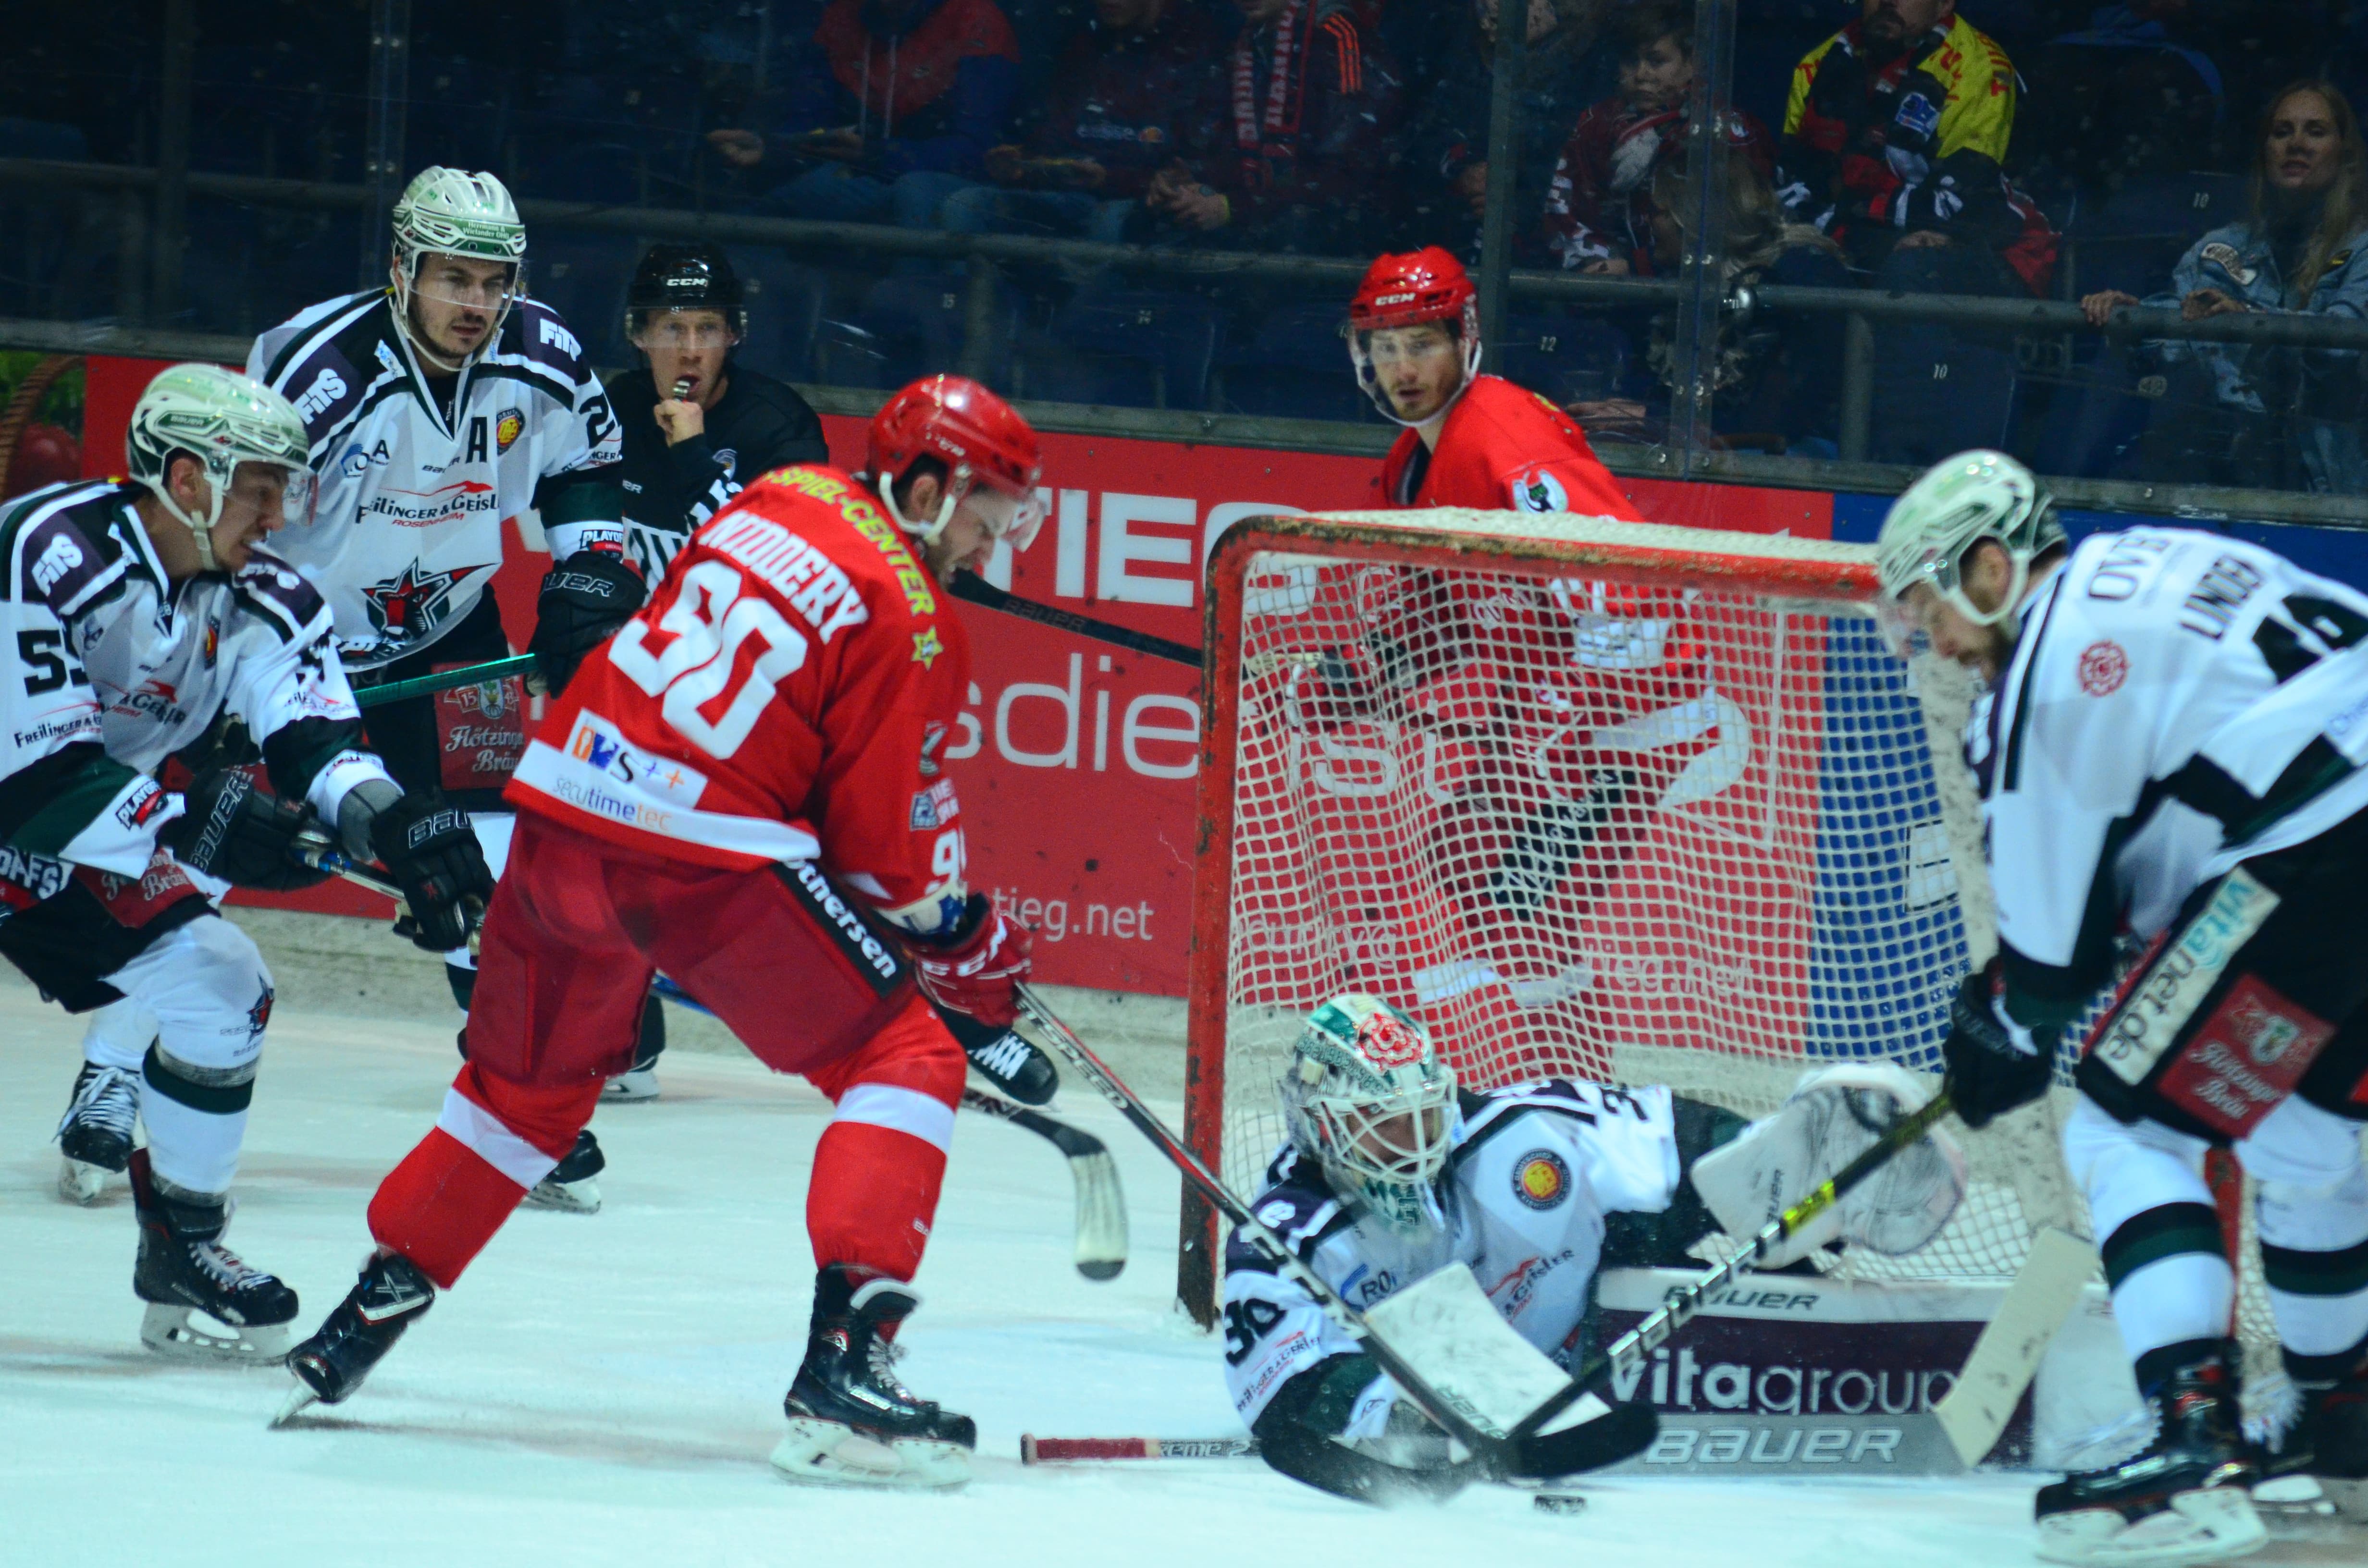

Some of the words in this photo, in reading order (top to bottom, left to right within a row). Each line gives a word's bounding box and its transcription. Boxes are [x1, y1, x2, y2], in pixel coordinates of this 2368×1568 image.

[463, 227, 494, 237] Wielander
[666, 277, 709, 287] CCM
[1375, 291, 1416, 306] CCM
[1540, 335, 1557, 352] 12
[465, 416, 487, 464] A
[698, 509, 869, 645] NIDDERY
[461, 691, 477, 708] 15
[553, 777, 673, 832] secutimetec
[783, 858, 897, 979] thersen
[992, 886, 1155, 943] tieg.net
[2105, 881, 2257, 1060] vitanet.de
[1664, 1285, 1820, 1312] BUER
[1609, 1347, 1959, 1415] vitagroup
